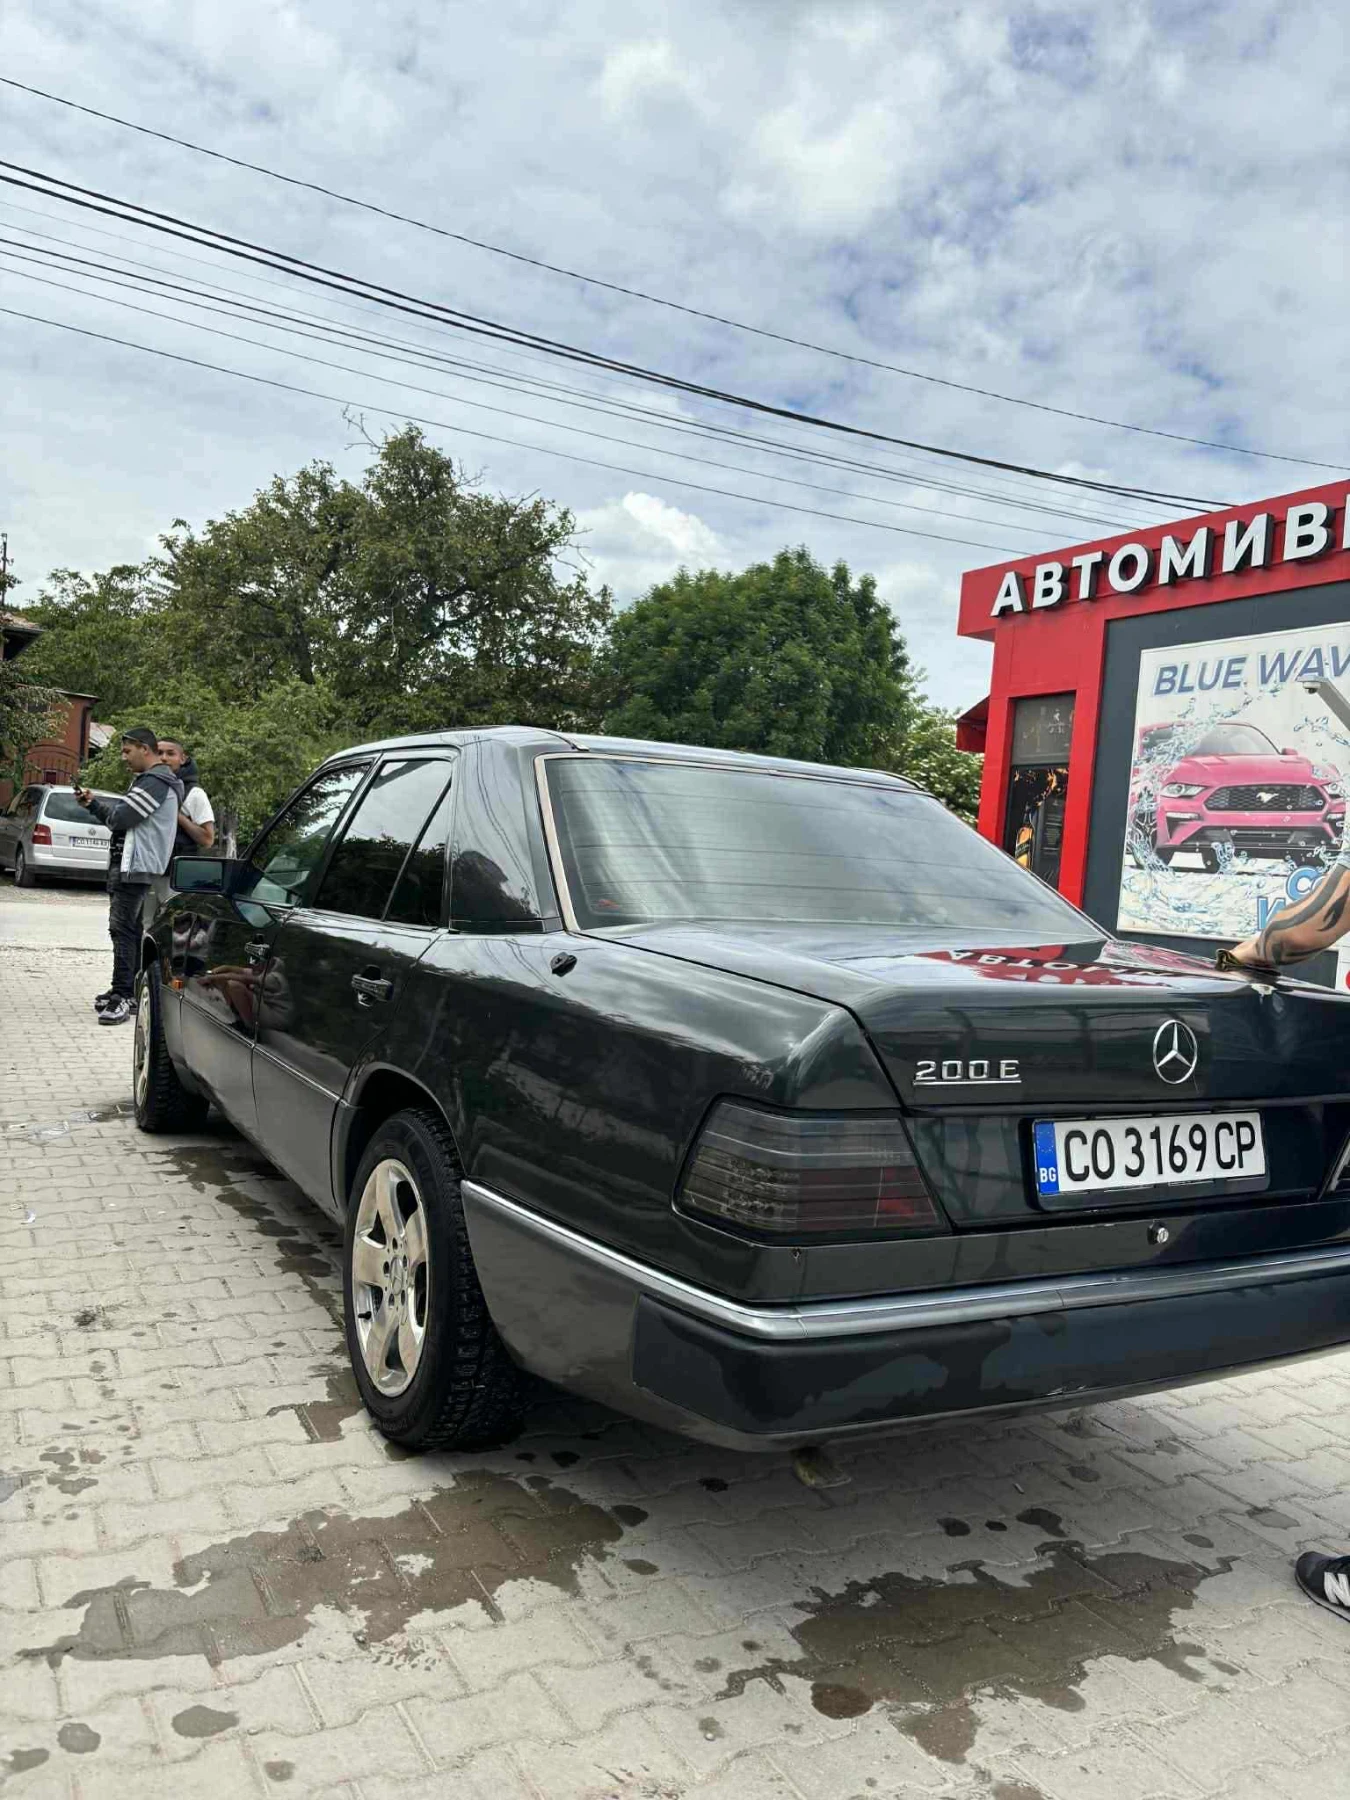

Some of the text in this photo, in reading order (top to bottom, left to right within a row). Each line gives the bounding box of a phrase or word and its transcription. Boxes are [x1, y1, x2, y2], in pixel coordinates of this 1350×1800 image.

[1154, 655, 1248, 696] BLUE
[915, 1059, 989, 1082] 200
[1064, 1120, 1256, 1182] CO 3169 CP
[1039, 1166, 1057, 1184] BG
